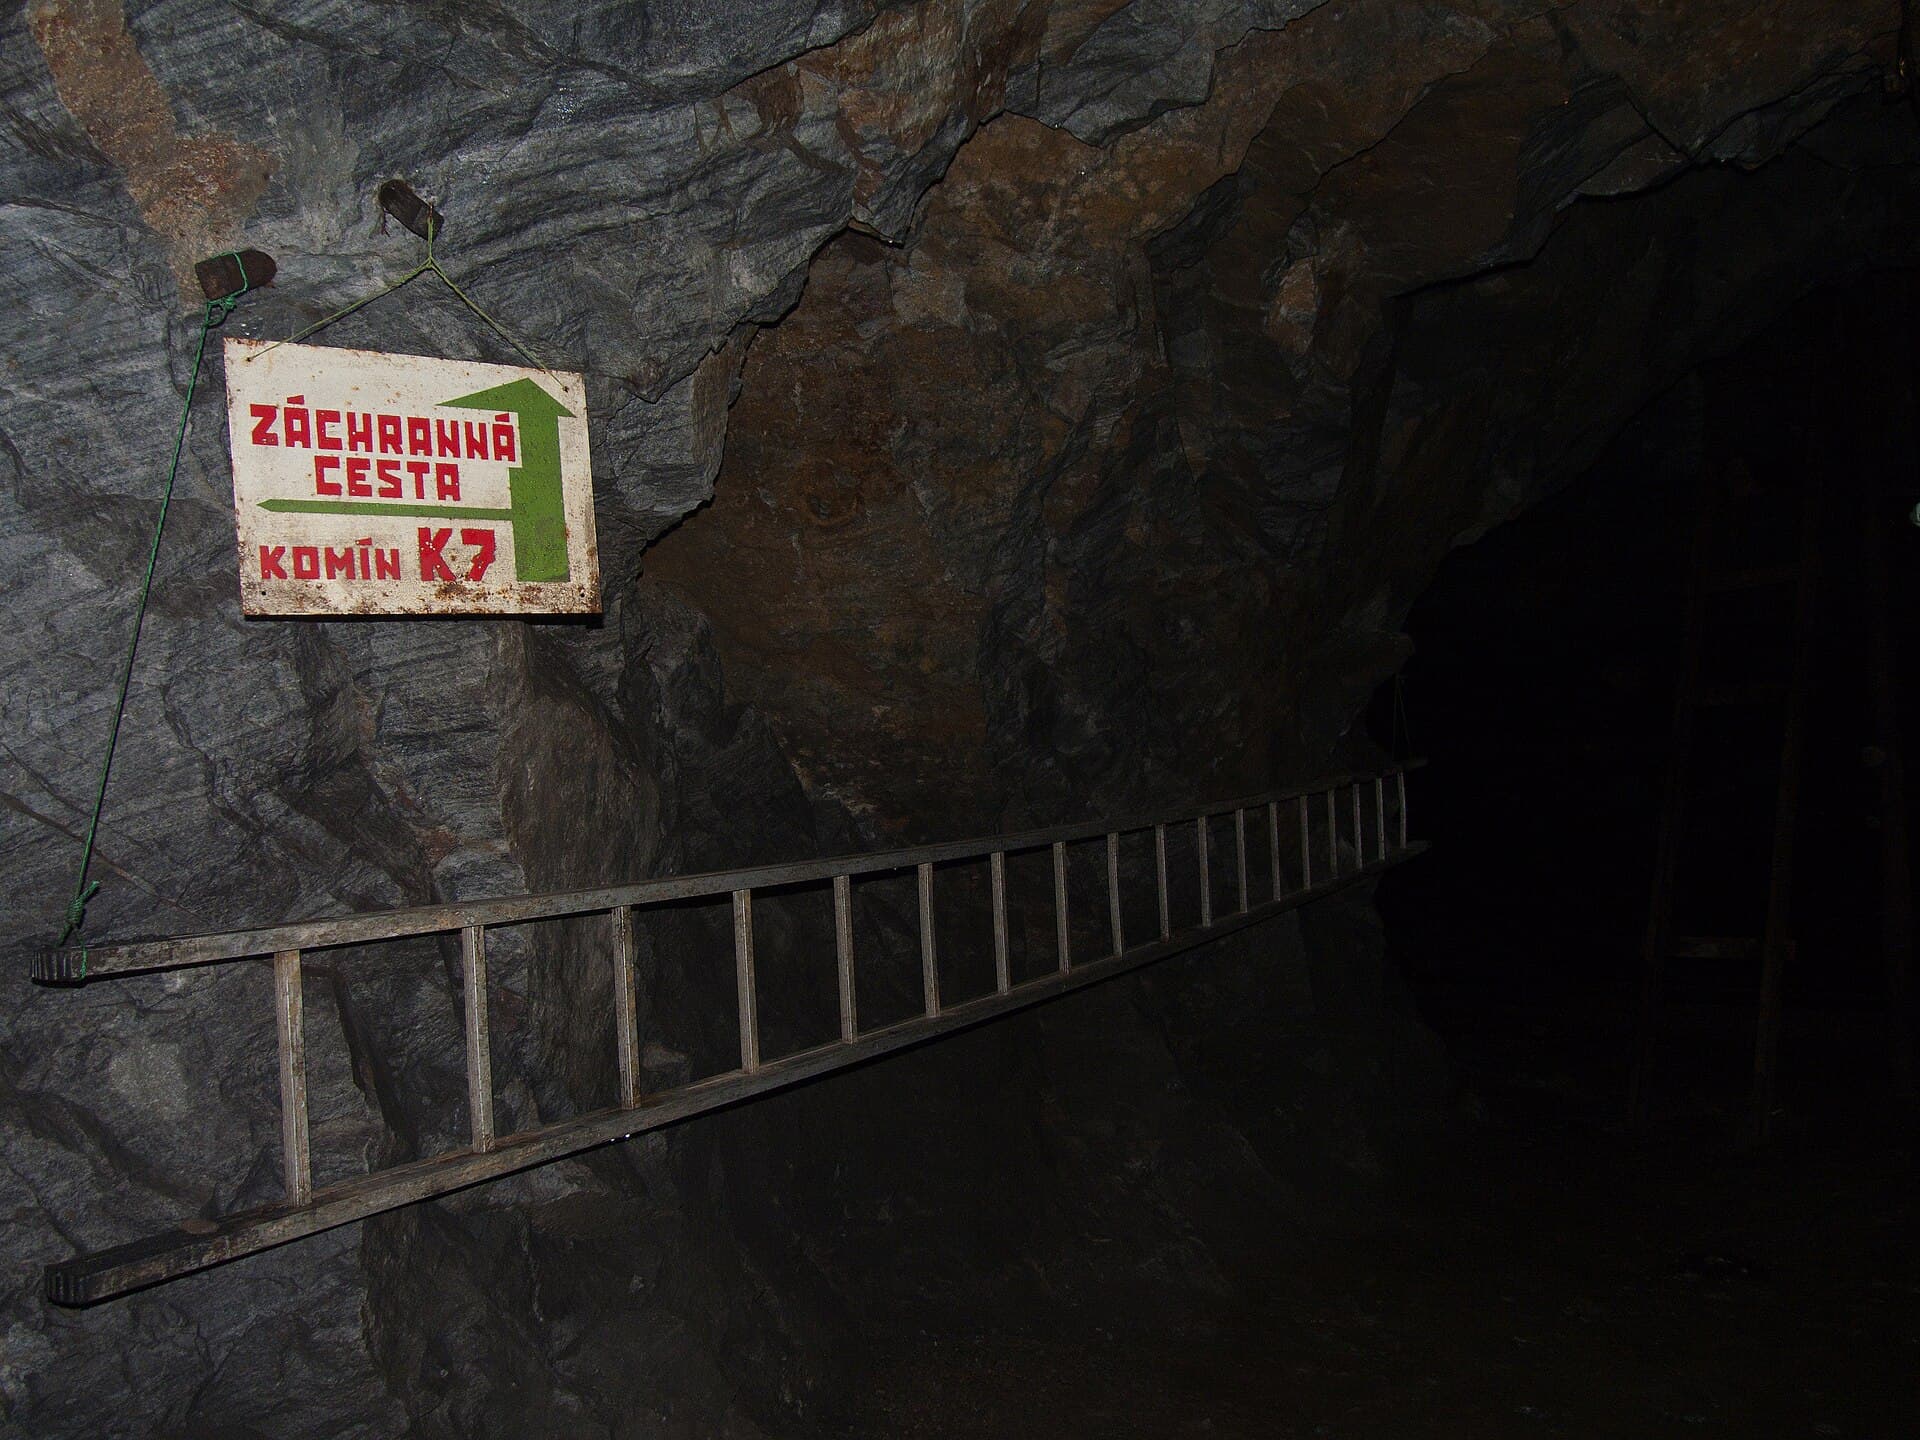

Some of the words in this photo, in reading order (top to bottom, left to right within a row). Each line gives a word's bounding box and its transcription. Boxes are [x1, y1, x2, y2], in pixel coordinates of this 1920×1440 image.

[250, 395, 516, 463] ZÁCHRANNÁ
[314, 455, 461, 502] CESTA
[259, 537, 401, 581] KOMÍN
[418, 527, 496, 582] K7
